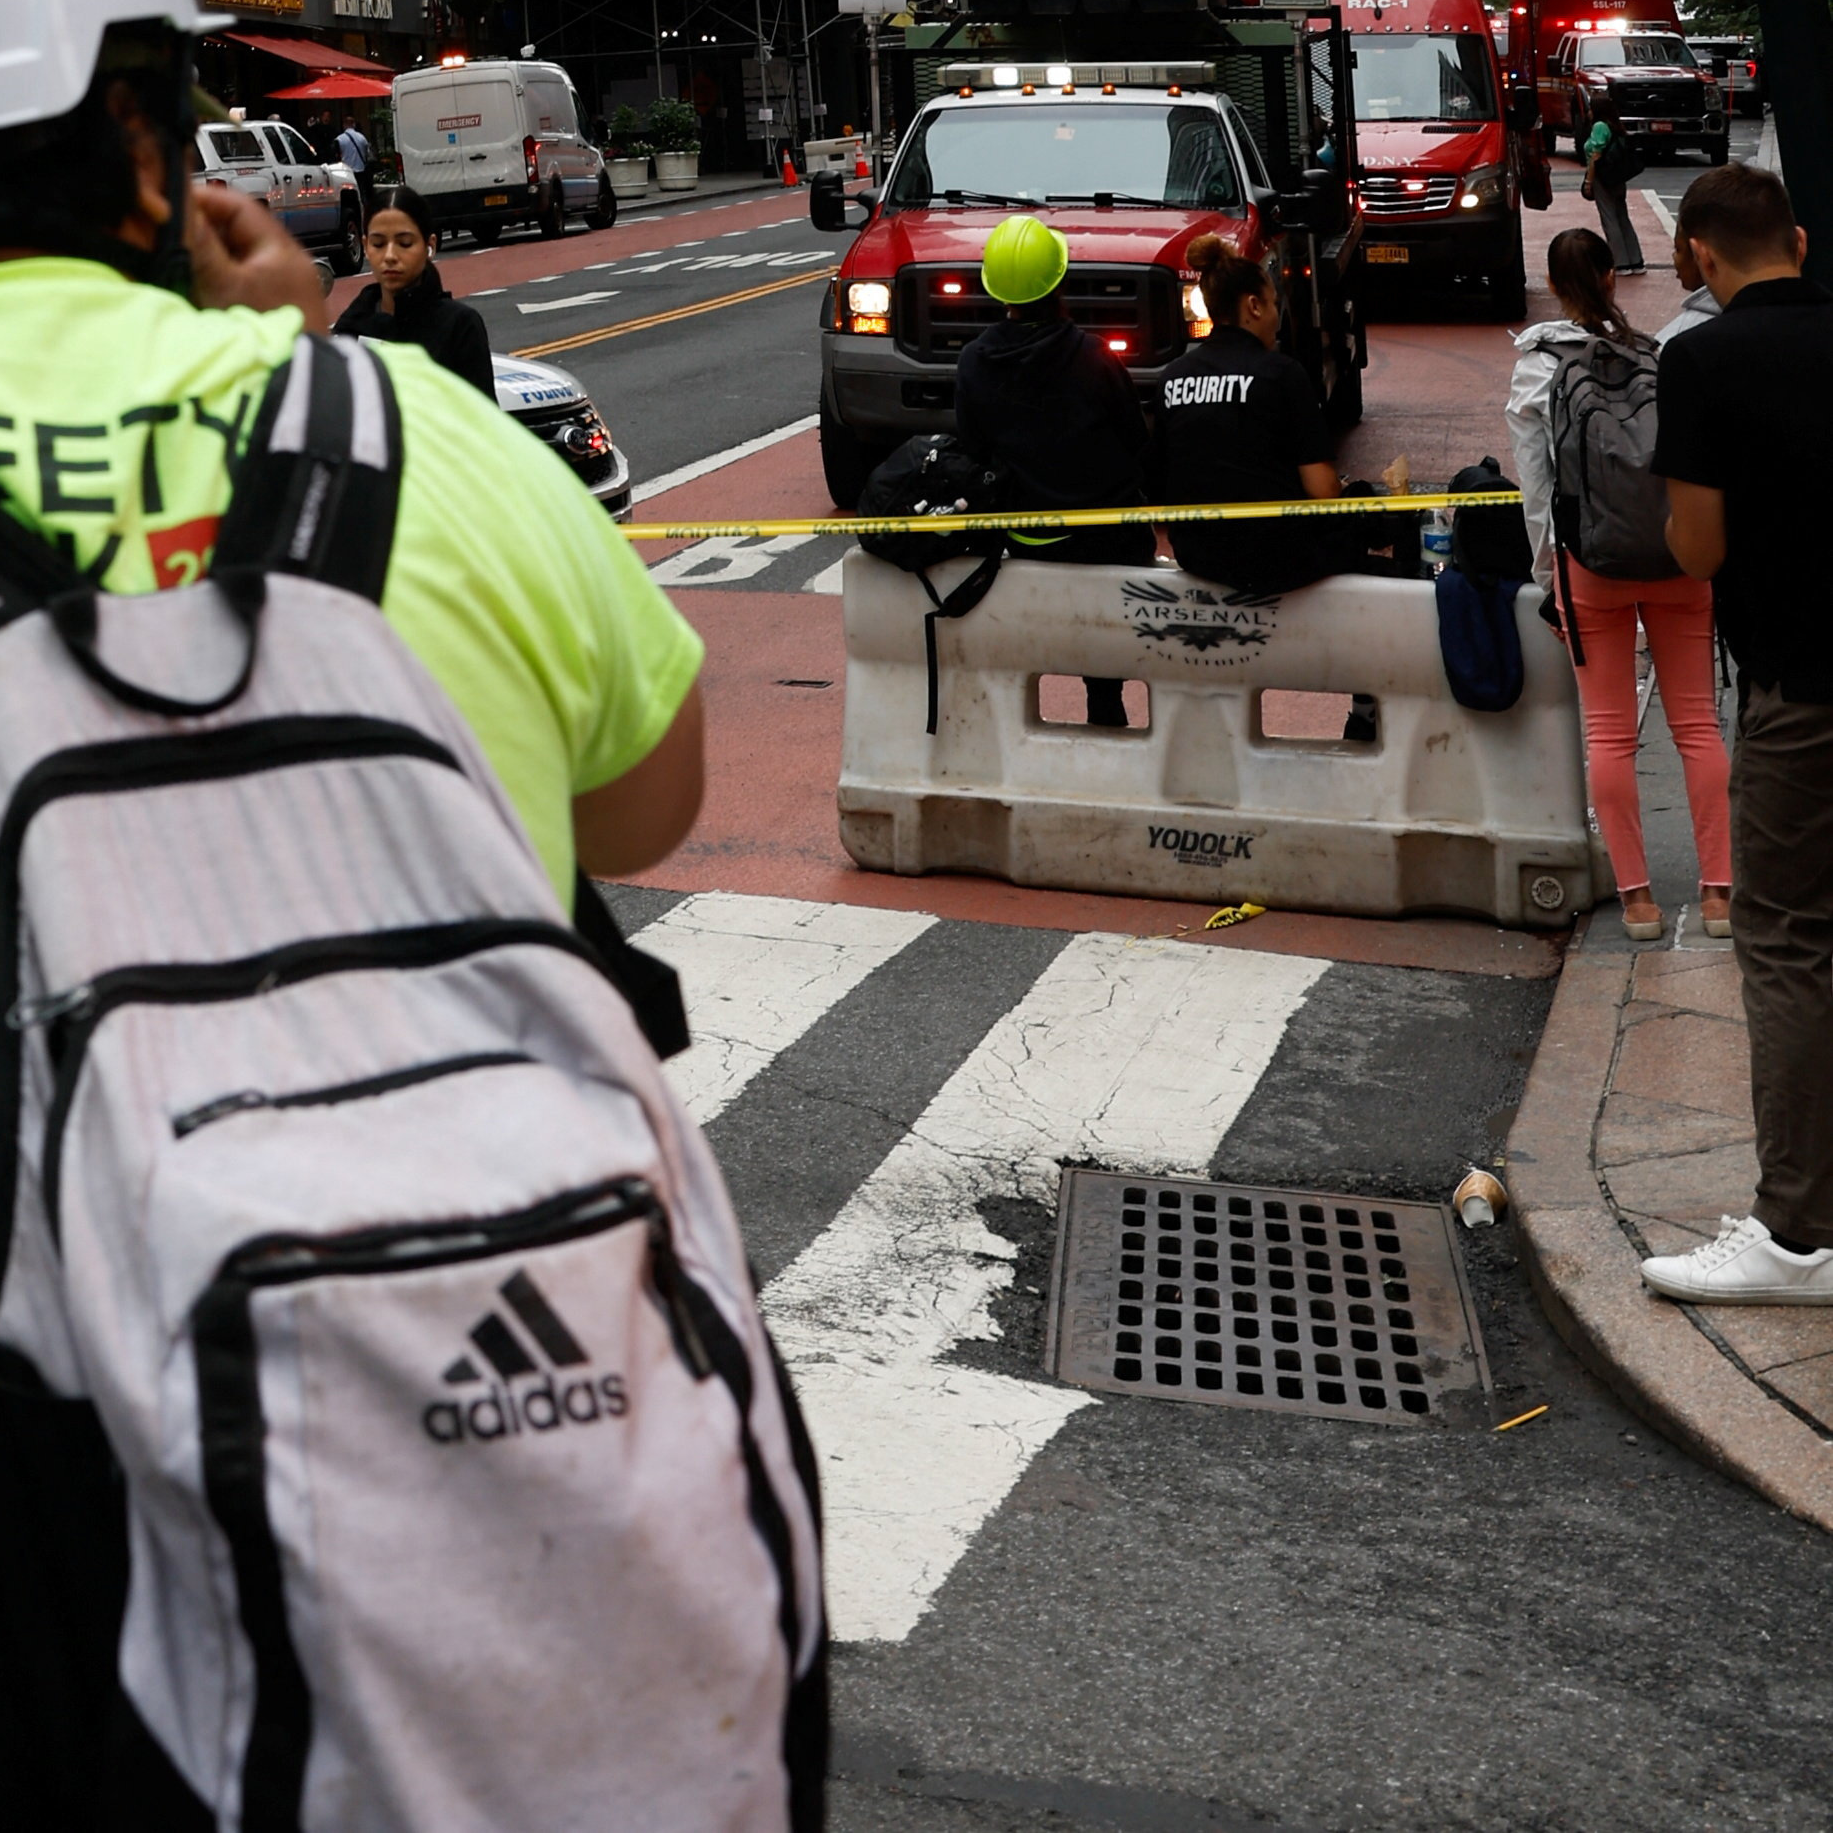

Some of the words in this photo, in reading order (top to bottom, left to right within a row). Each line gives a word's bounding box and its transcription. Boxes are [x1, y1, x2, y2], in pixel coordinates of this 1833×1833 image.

[438, 116, 480, 130] EMERGENCY
[1363, 156, 1419, 168] D.N.Y.
[1164, 374, 1254, 409] SECURITY
[1134, 605, 1269, 627] ARSENAL
[423, 1372, 629, 1444] adidas
